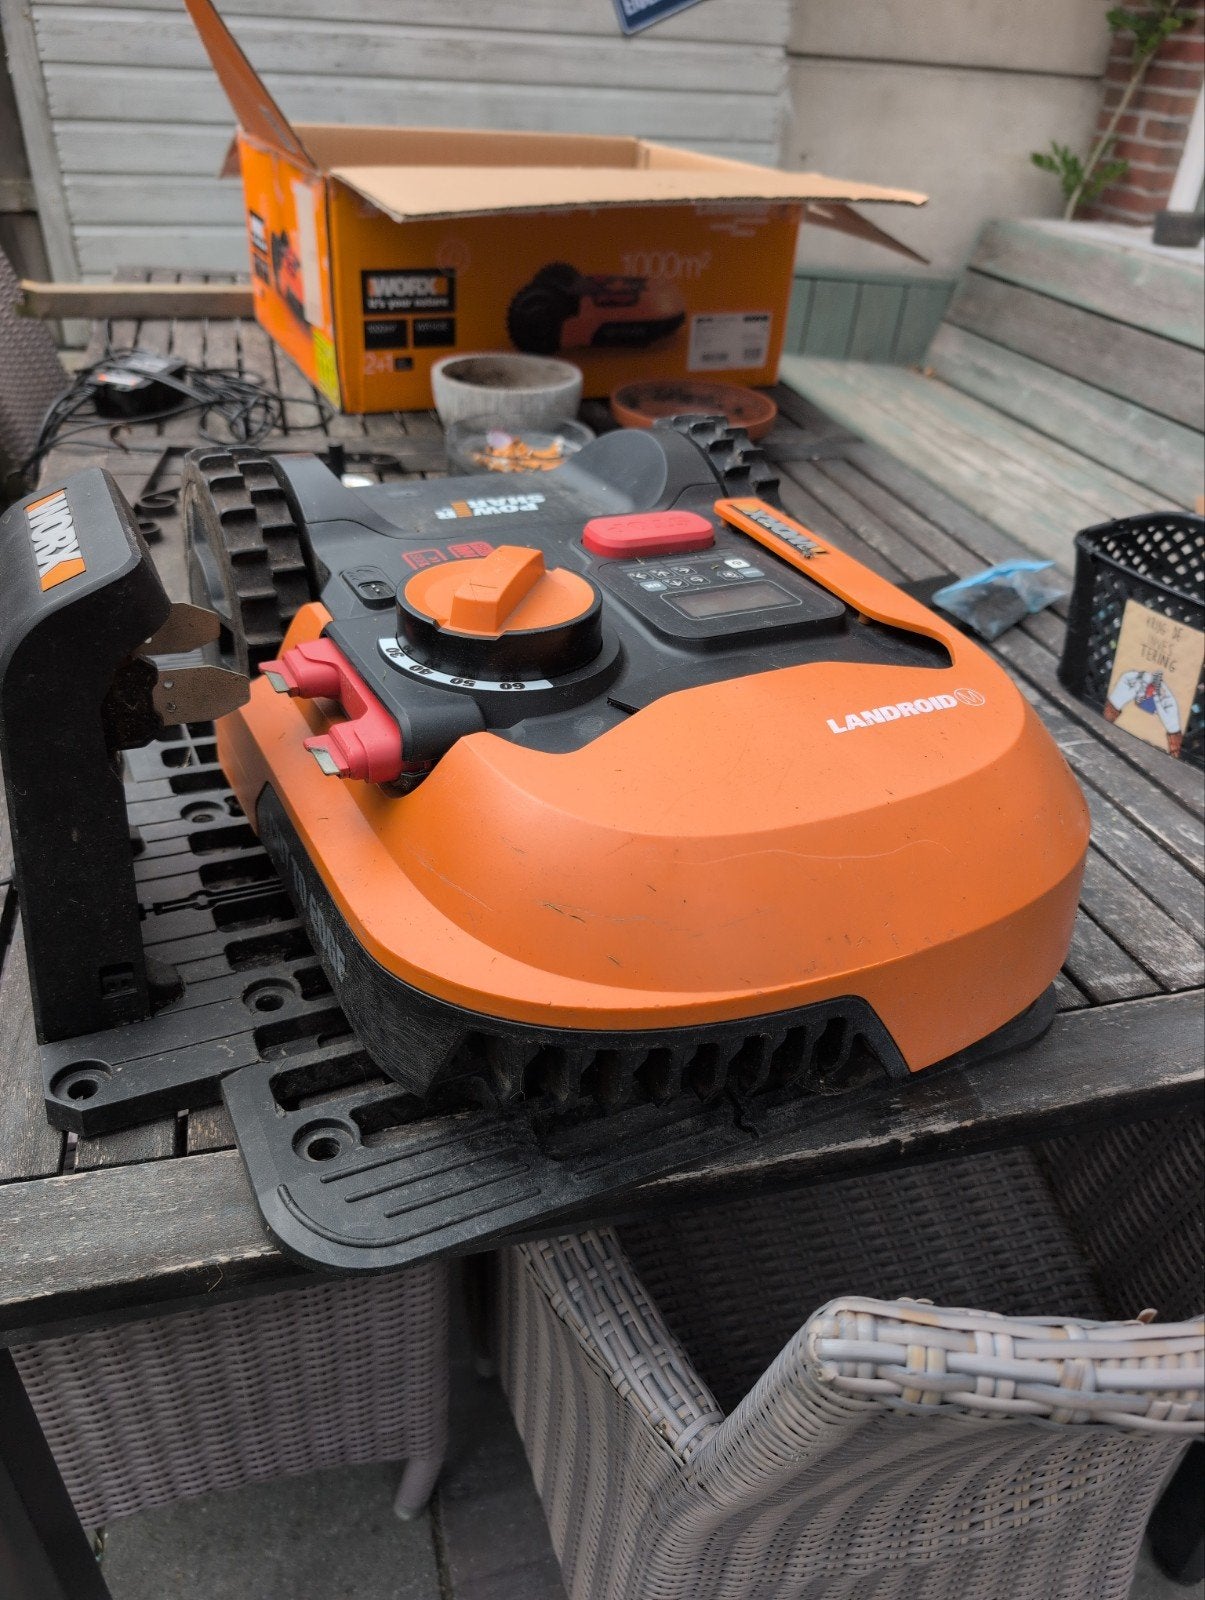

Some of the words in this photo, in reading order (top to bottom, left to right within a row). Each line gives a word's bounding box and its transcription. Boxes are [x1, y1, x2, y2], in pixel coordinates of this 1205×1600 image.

[27, 489, 84, 579] WORX
[385, 647, 405, 659] 30
[409, 665, 433, 676] 40
[450, 677, 476, 688] 50
[499, 682, 526, 690] 60
[826, 694, 958, 734] LANDROID
